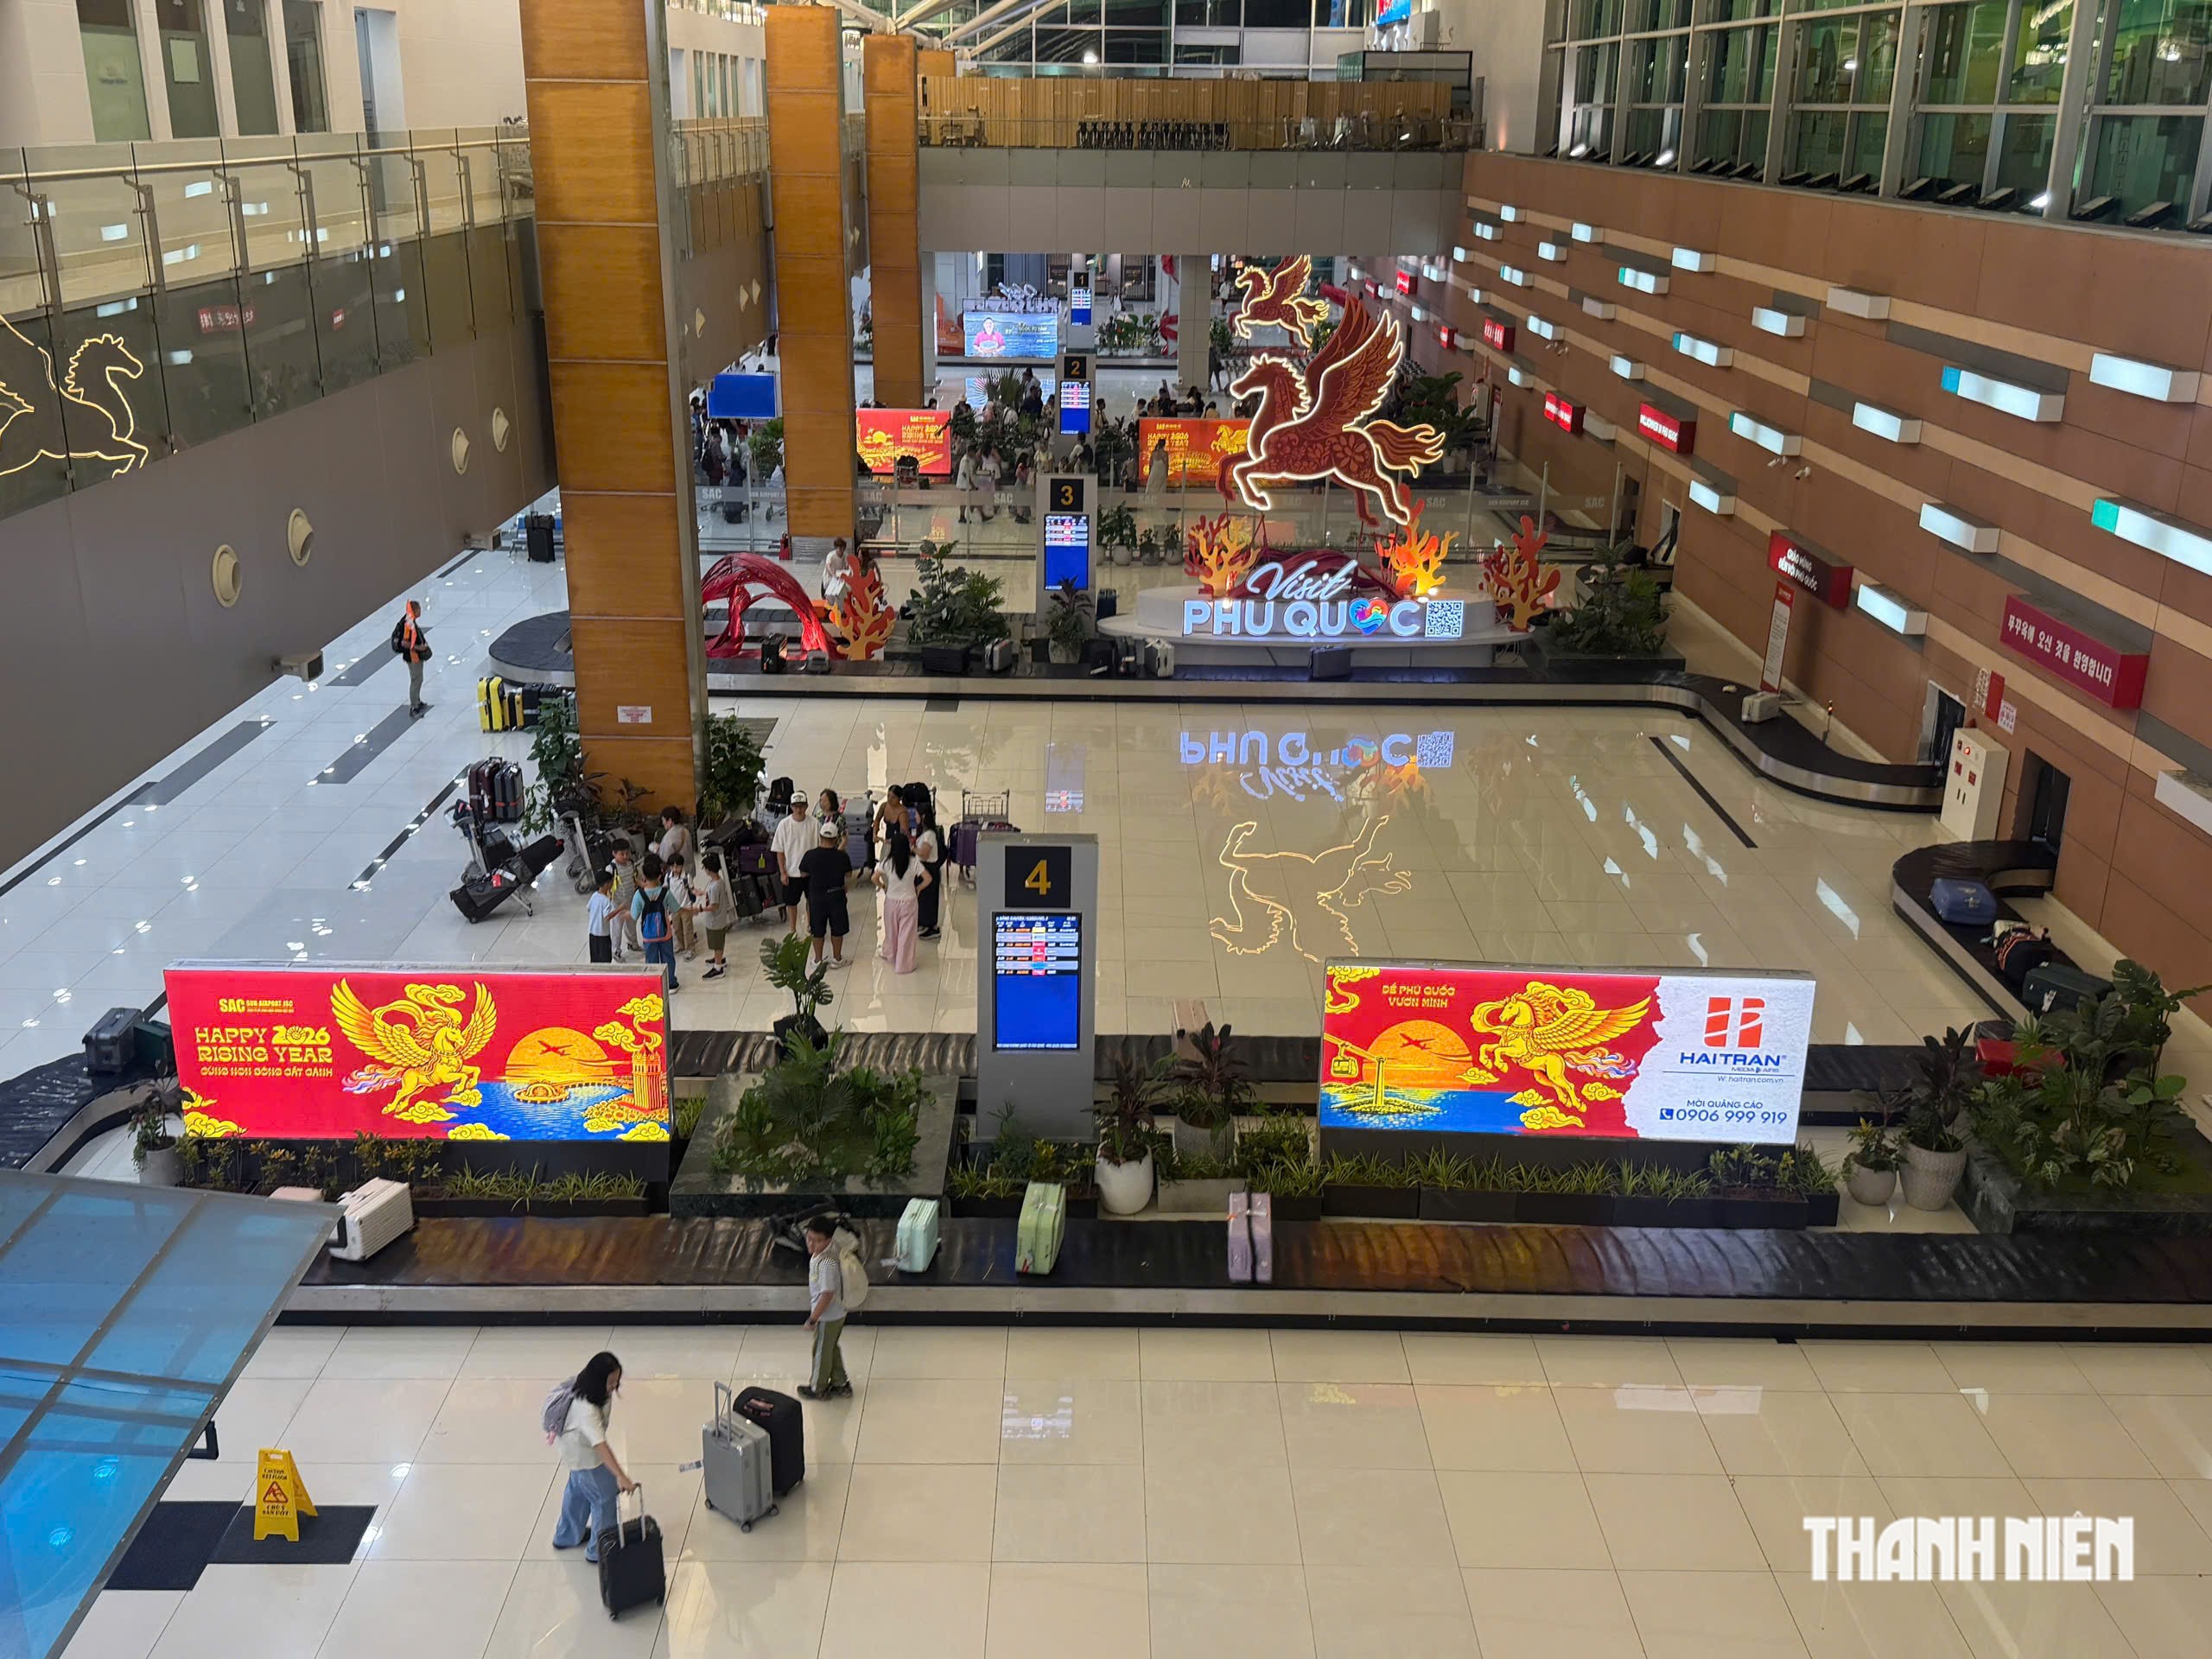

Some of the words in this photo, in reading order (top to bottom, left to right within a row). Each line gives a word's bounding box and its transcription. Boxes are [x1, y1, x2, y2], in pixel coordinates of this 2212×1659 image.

[1078, 275, 1084, 285] 1
[1071, 360, 1080, 375] 2
[702, 487, 722, 499] SAC
[994, 492, 1014, 505] SAC
[1060, 485, 1073, 505] 3
[1426, 497, 1446, 509] SAC
[1585, 497, 1605, 508] SAC
[1246, 560, 1358, 601] Visit
[1182, 599, 1274, 637] PHU
[2037, 631, 2053, 653] 오신
[2055, 639, 2071, 664] 것을
[2073, 650, 2113, 687] 환영합니다
[1025, 859, 1052, 895] 4
[219, 998, 245, 1013] SAC
[194, 1027, 268, 1044] HAPPY
[271, 1025, 332, 1046] 2026
[197, 1046, 269, 1063] RISING
[273, 1046, 333, 1064] YEAR
[1687, 1098, 1705, 1107] MỜI
[1707, 1099, 1741, 1109] QUẢNG
[1743, 1100, 1764, 1109] CÁO
[1676, 1109, 1719, 1122] 0906
[1725, 1109, 1756, 1123] 999
[1761, 1111, 1788, 1124] 919
